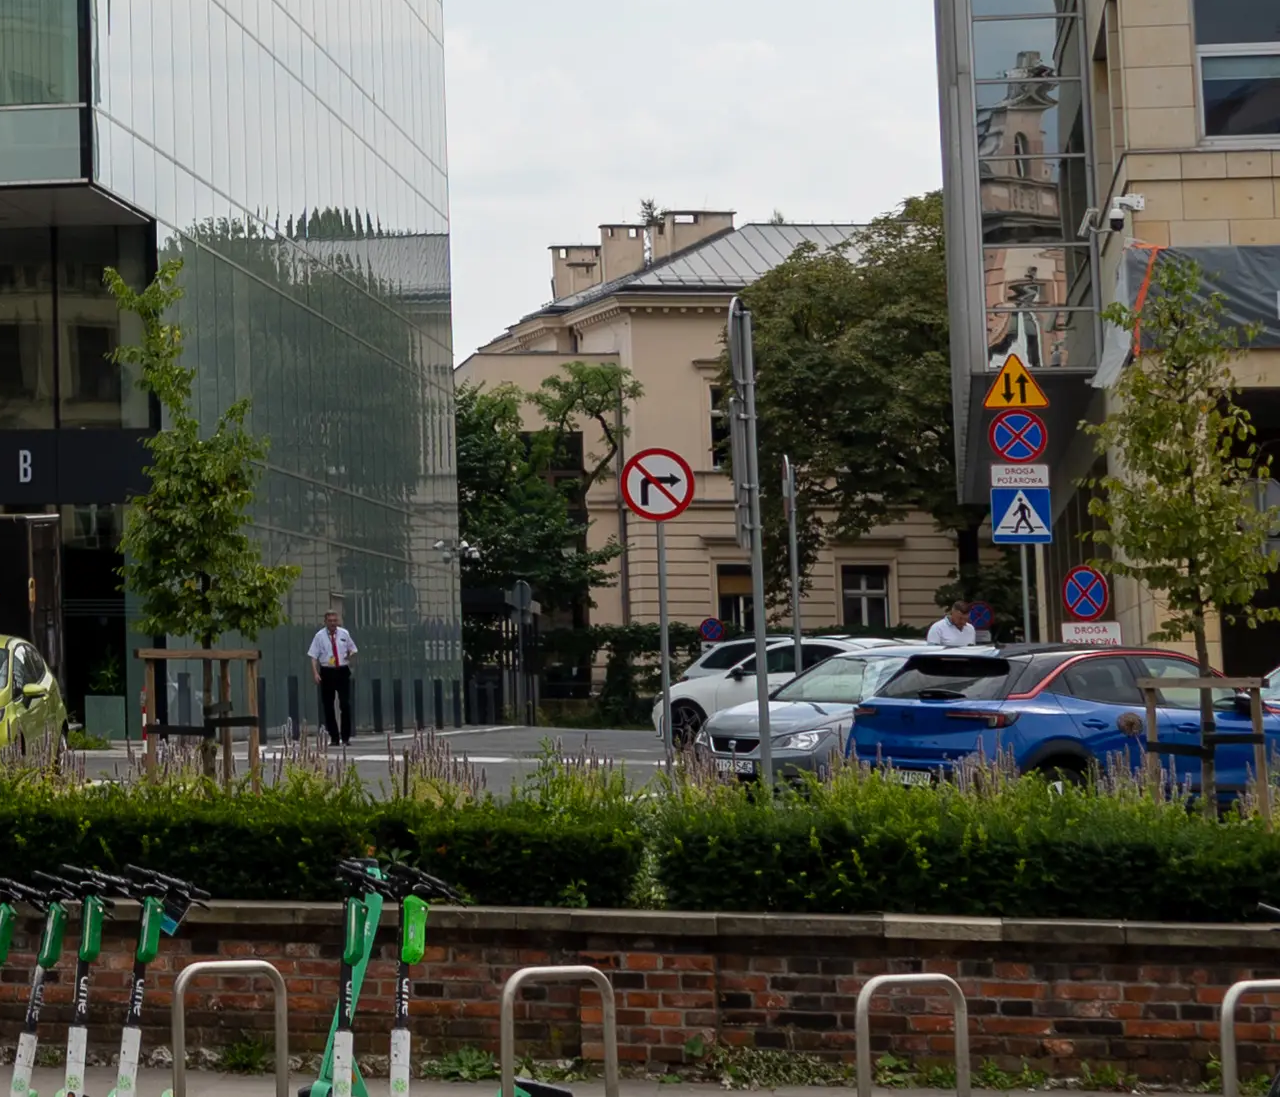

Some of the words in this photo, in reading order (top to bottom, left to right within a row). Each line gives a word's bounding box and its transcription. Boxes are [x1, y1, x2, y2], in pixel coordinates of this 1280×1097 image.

[19, 450, 32, 483] B
[997, 476, 1043, 484] POŻAROWA
[1074, 626, 1108, 634] DROGA
